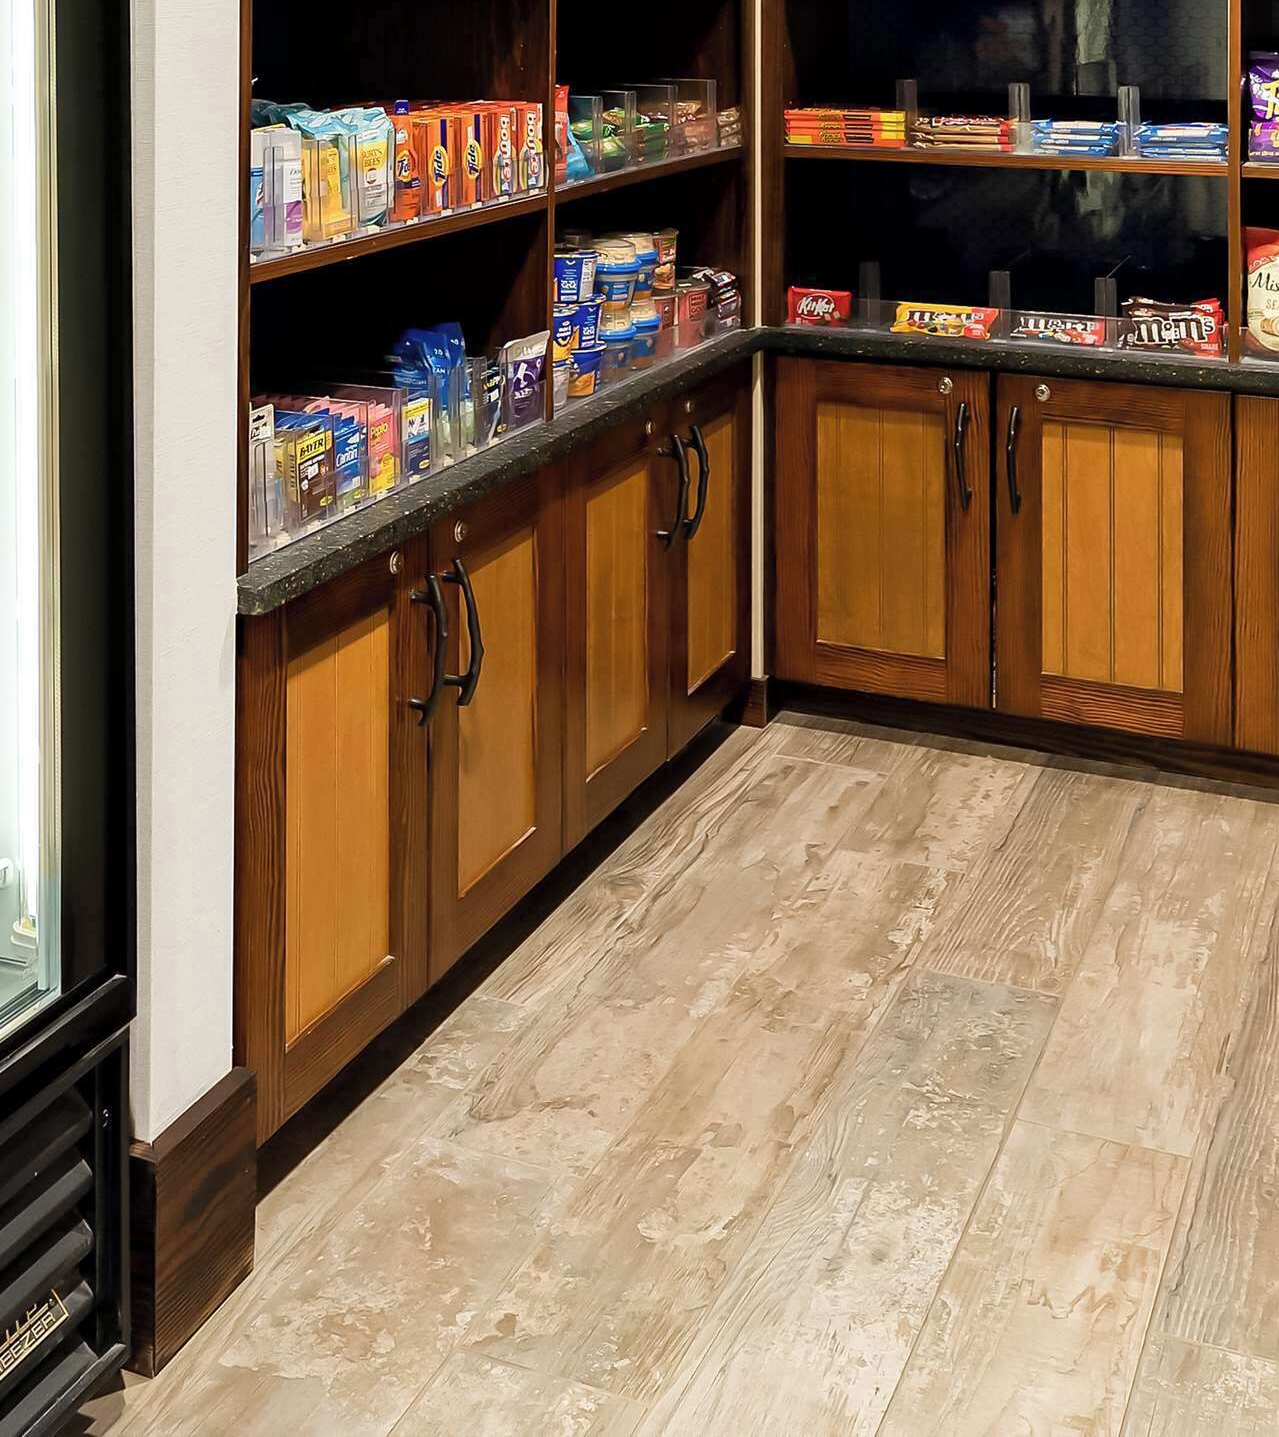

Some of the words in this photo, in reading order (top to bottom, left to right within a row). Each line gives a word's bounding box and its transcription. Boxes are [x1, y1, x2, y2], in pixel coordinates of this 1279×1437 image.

[434, 150, 446, 184] Tide
[467, 144, 479, 175] Tide
[499, 114, 512, 182] Bounce
[526, 111, 539, 177] Bounce
